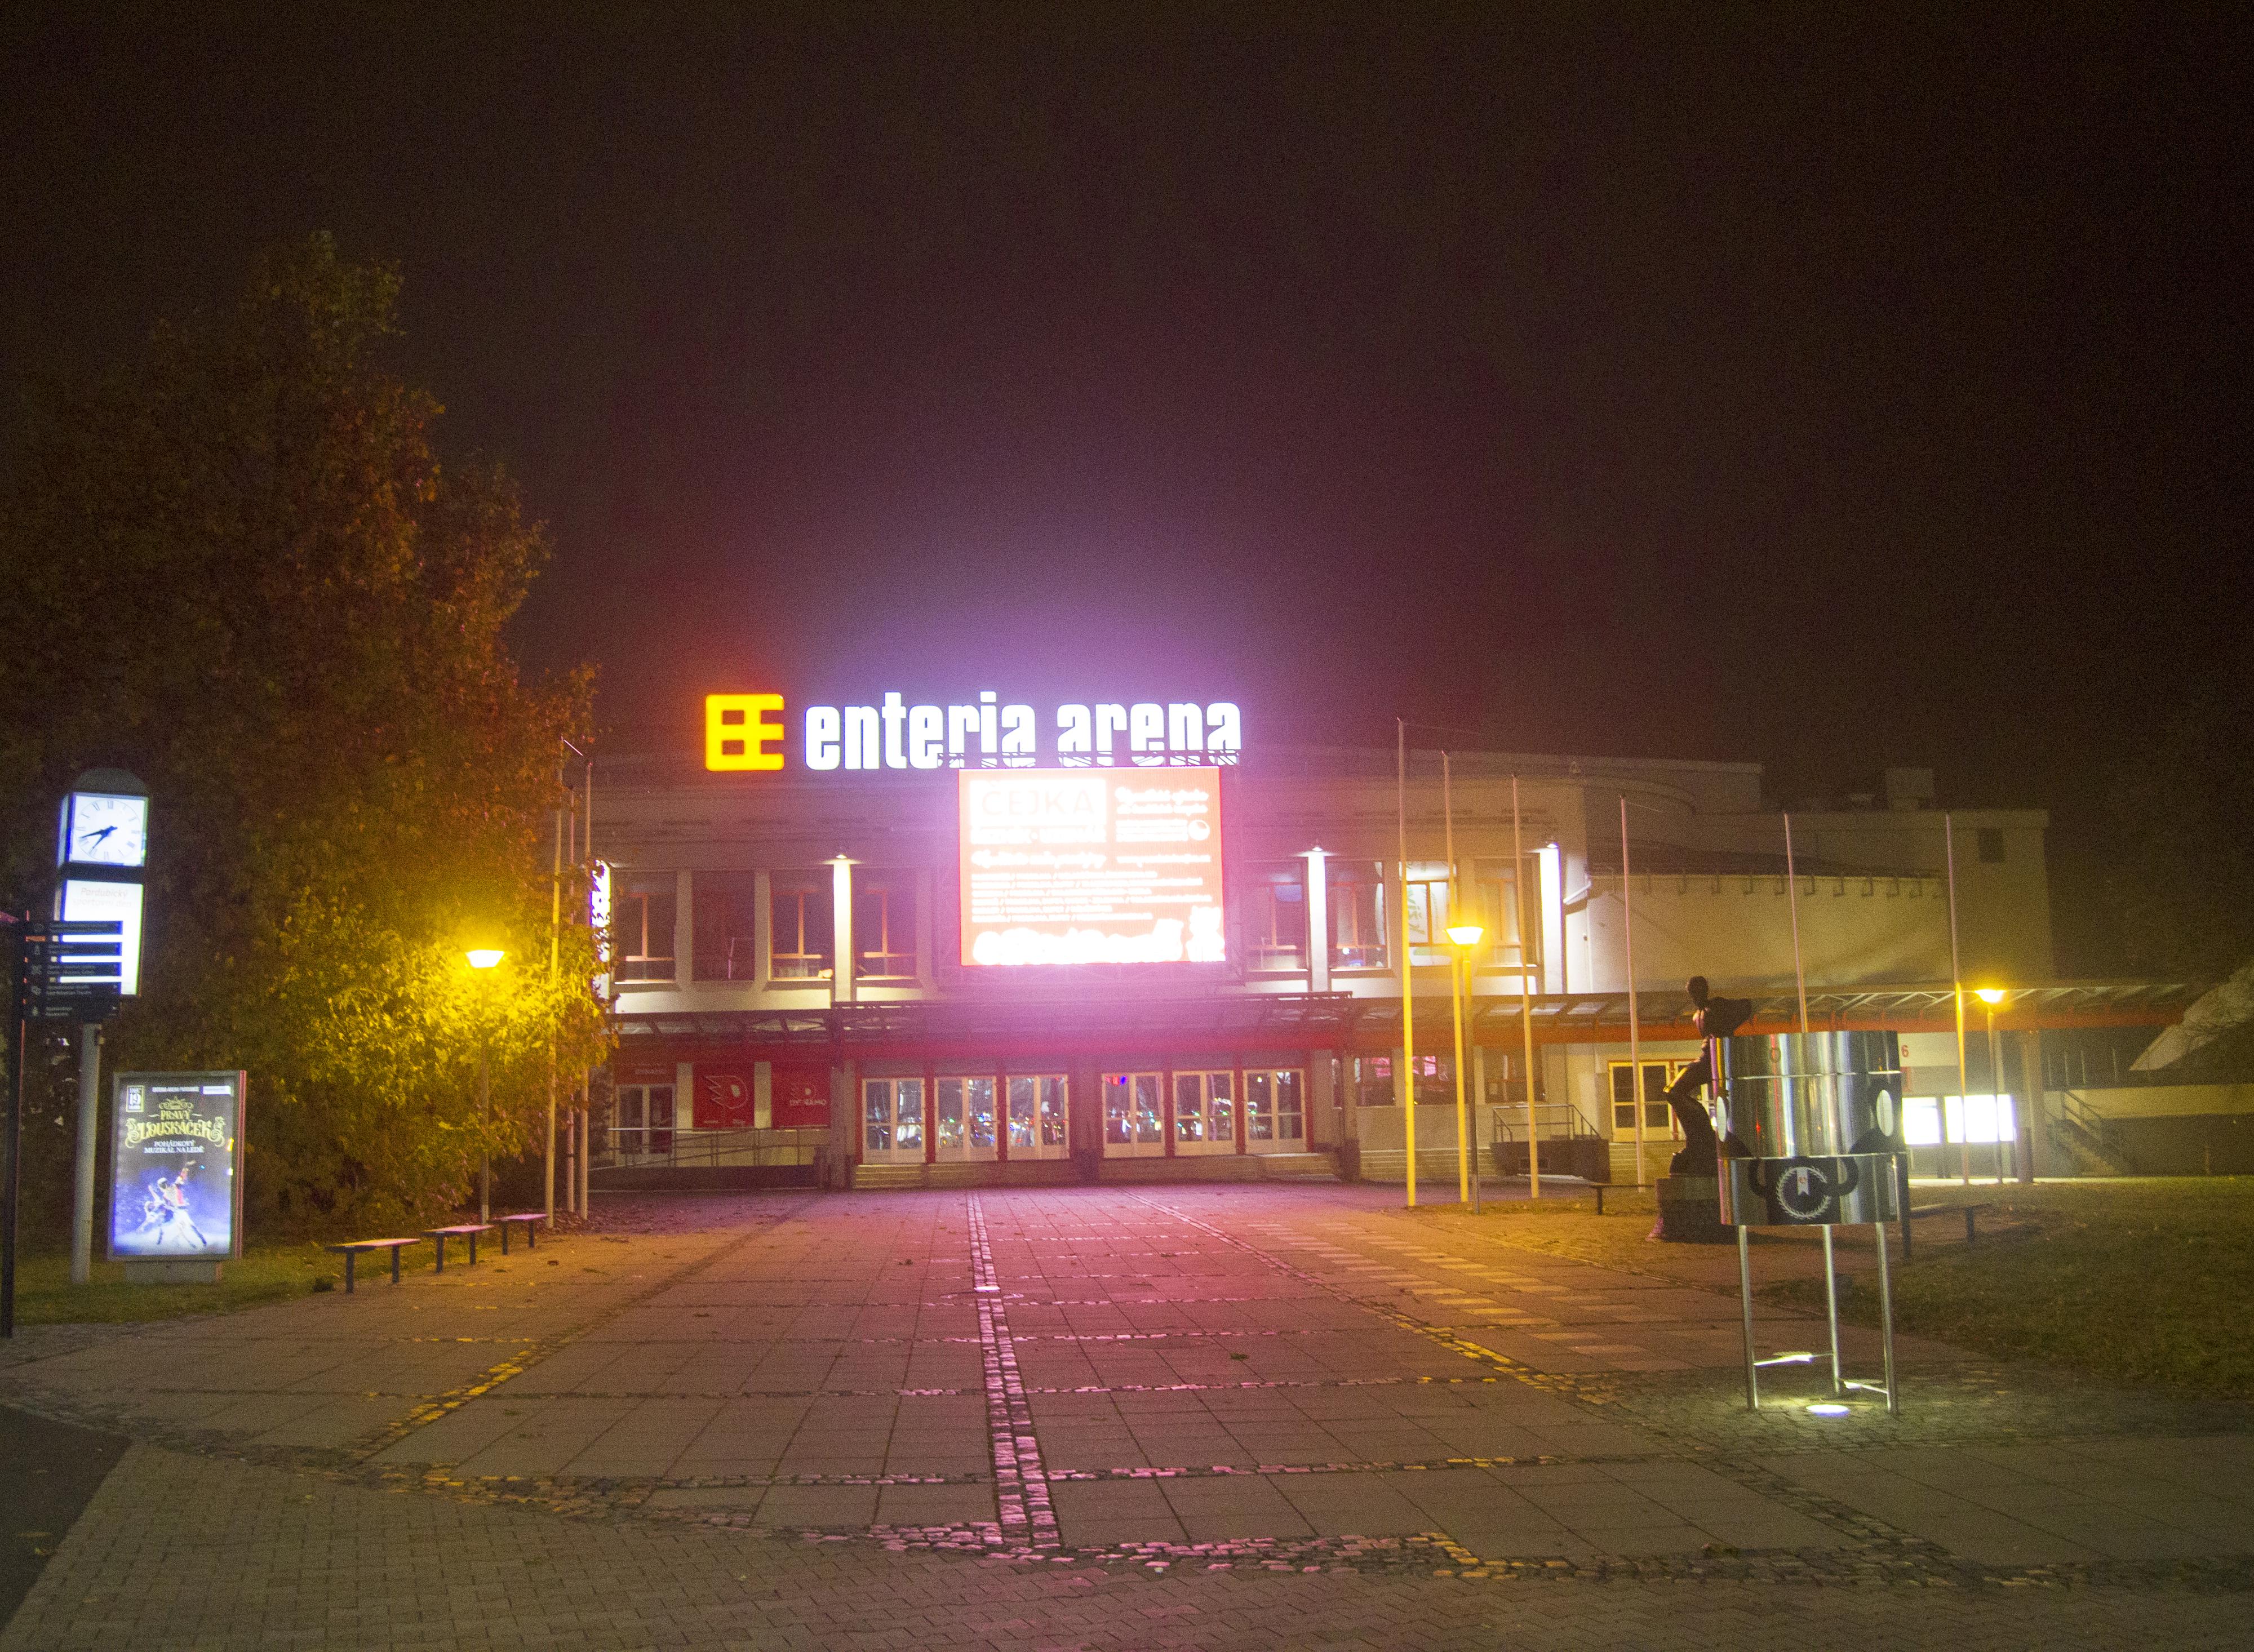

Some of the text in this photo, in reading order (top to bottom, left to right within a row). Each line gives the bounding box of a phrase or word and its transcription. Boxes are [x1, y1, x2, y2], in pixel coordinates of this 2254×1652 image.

[805, 691, 1242, 770] enteria arena
[981, 780, 1095, 815] ČEJKA
[81, 887, 128, 899] Pardubický
[1901, 1045, 1909, 1058] 6
[160, 1109, 191, 1120] PRAVÝ
